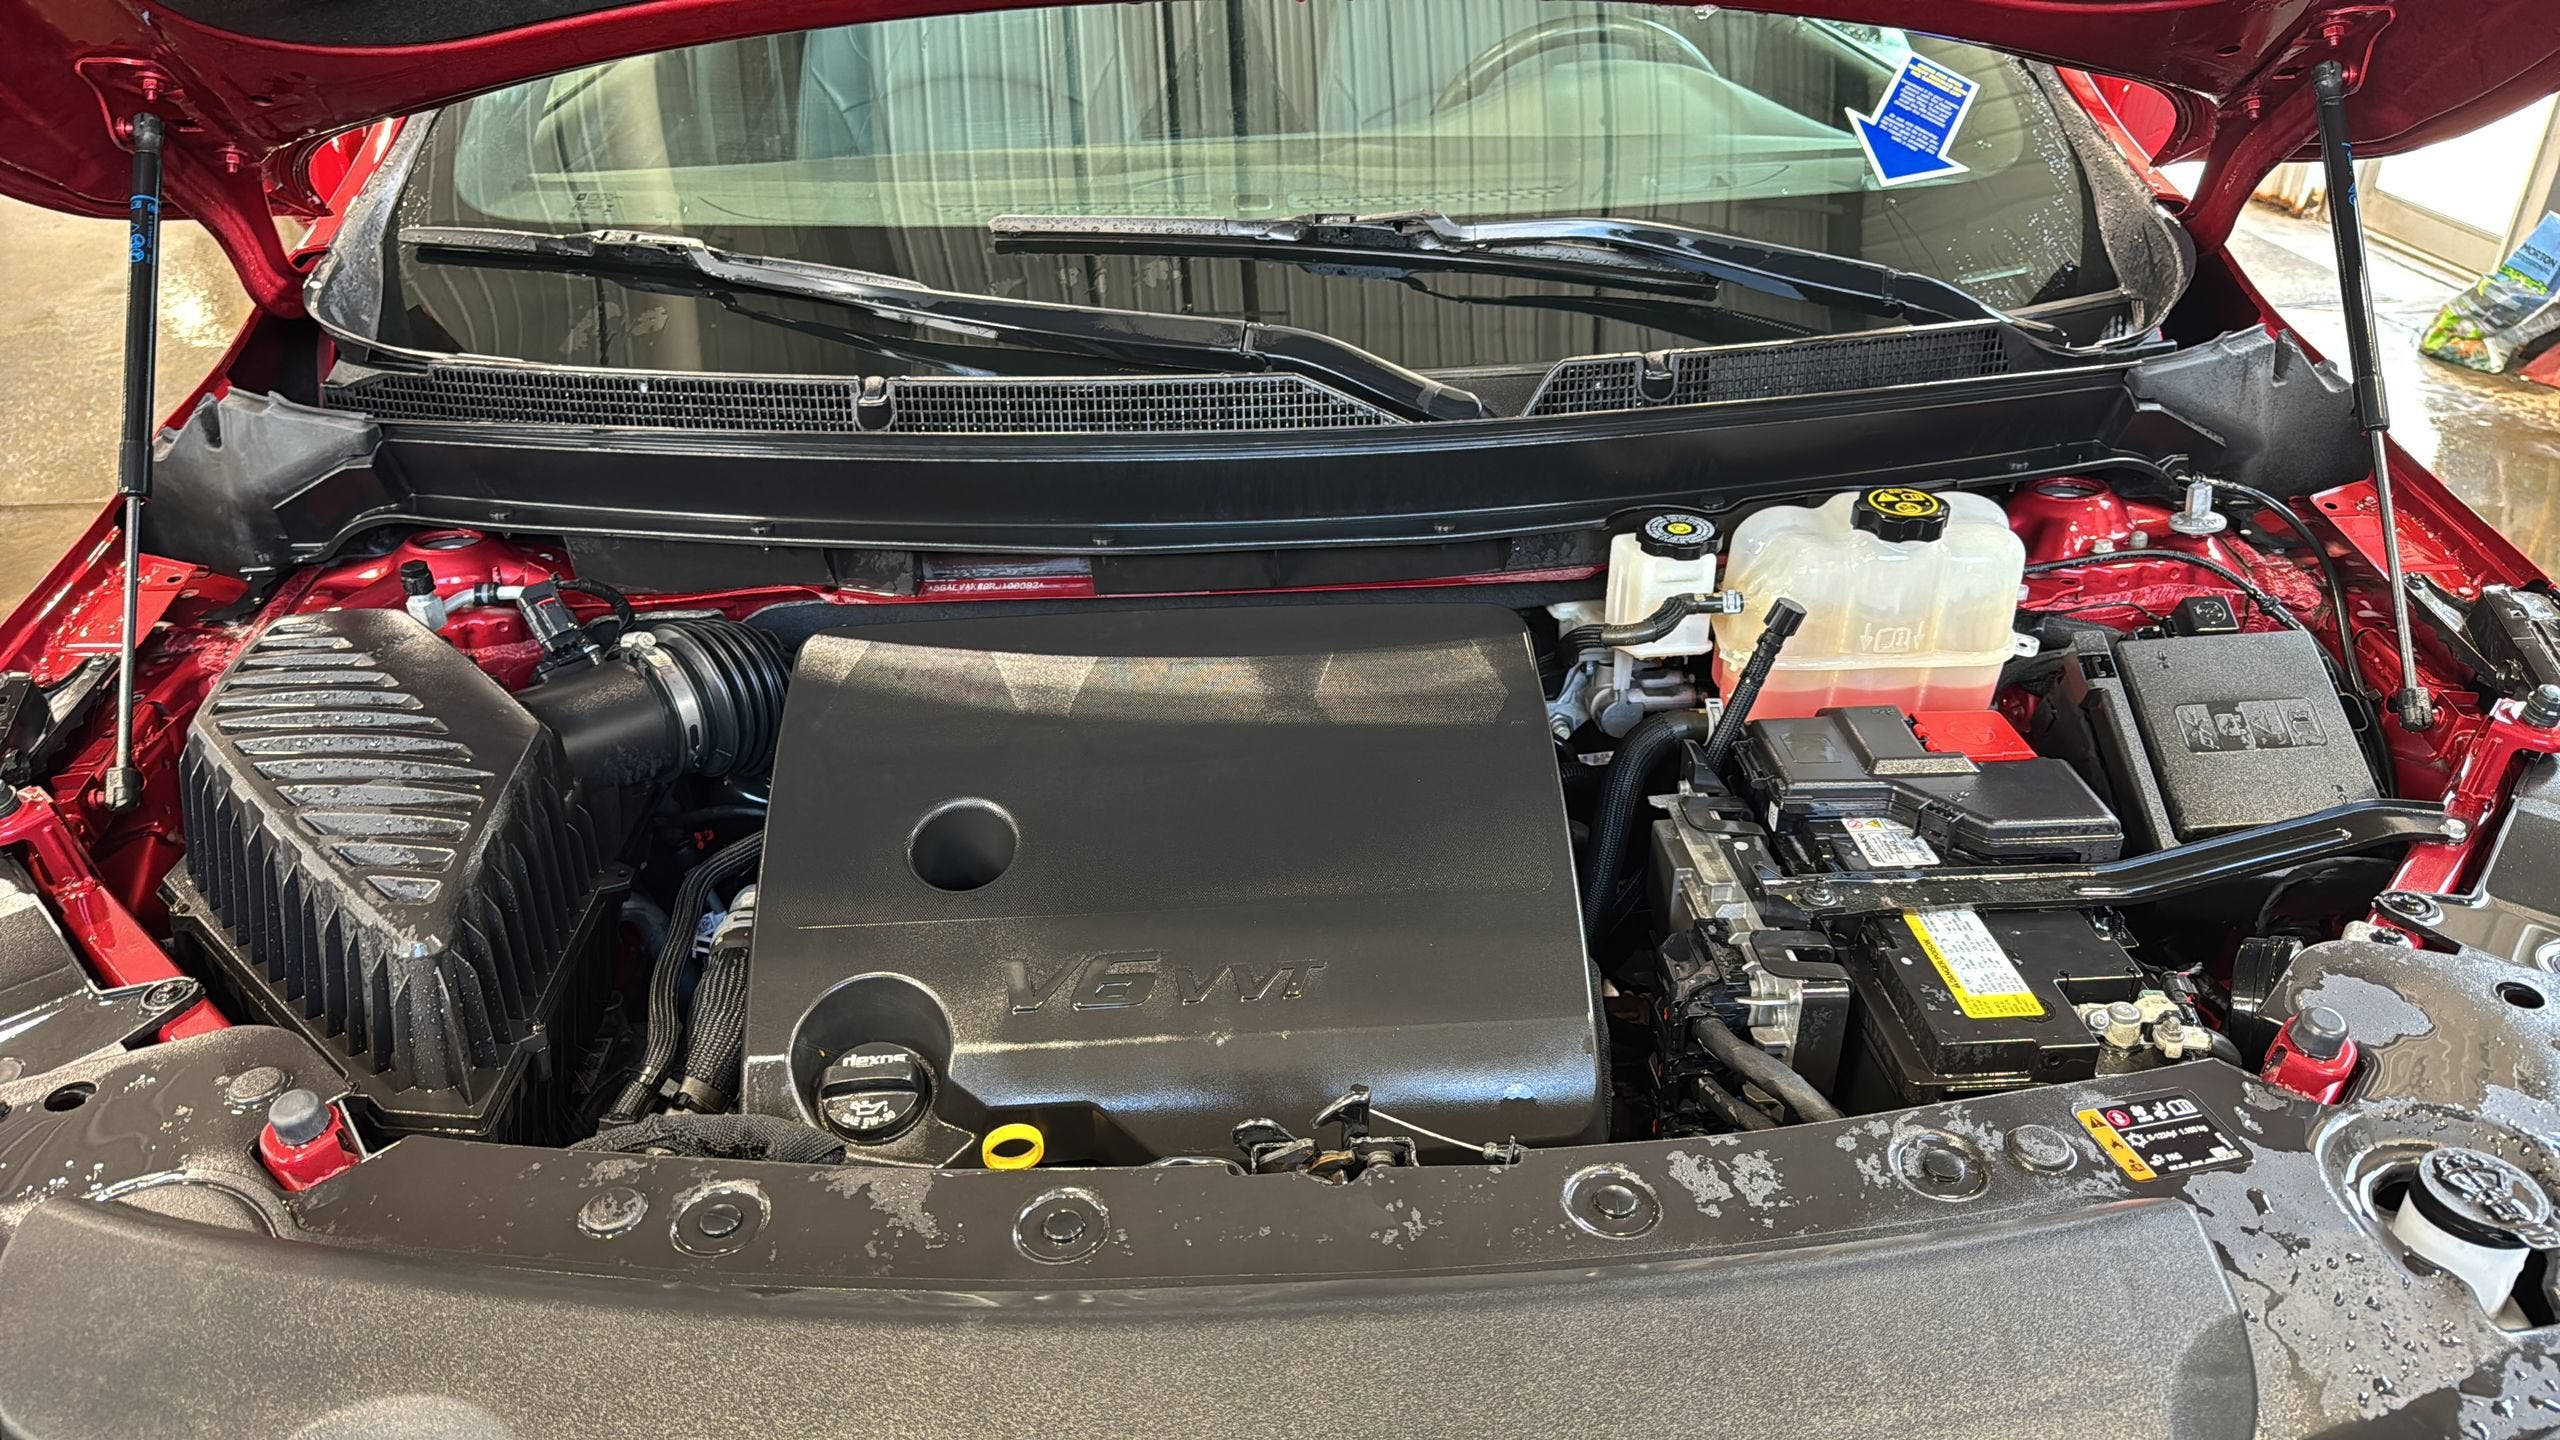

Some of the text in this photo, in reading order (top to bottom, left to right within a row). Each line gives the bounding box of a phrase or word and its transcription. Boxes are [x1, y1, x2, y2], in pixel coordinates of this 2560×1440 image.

[2519, 242, 2558, 268] MORTON
[1923, 939, 1958, 983] DANGER POISON
[1000, 951, 1328, 1014] V6 VVT
[842, 1110, 896, 1129] SAE 5W-30
